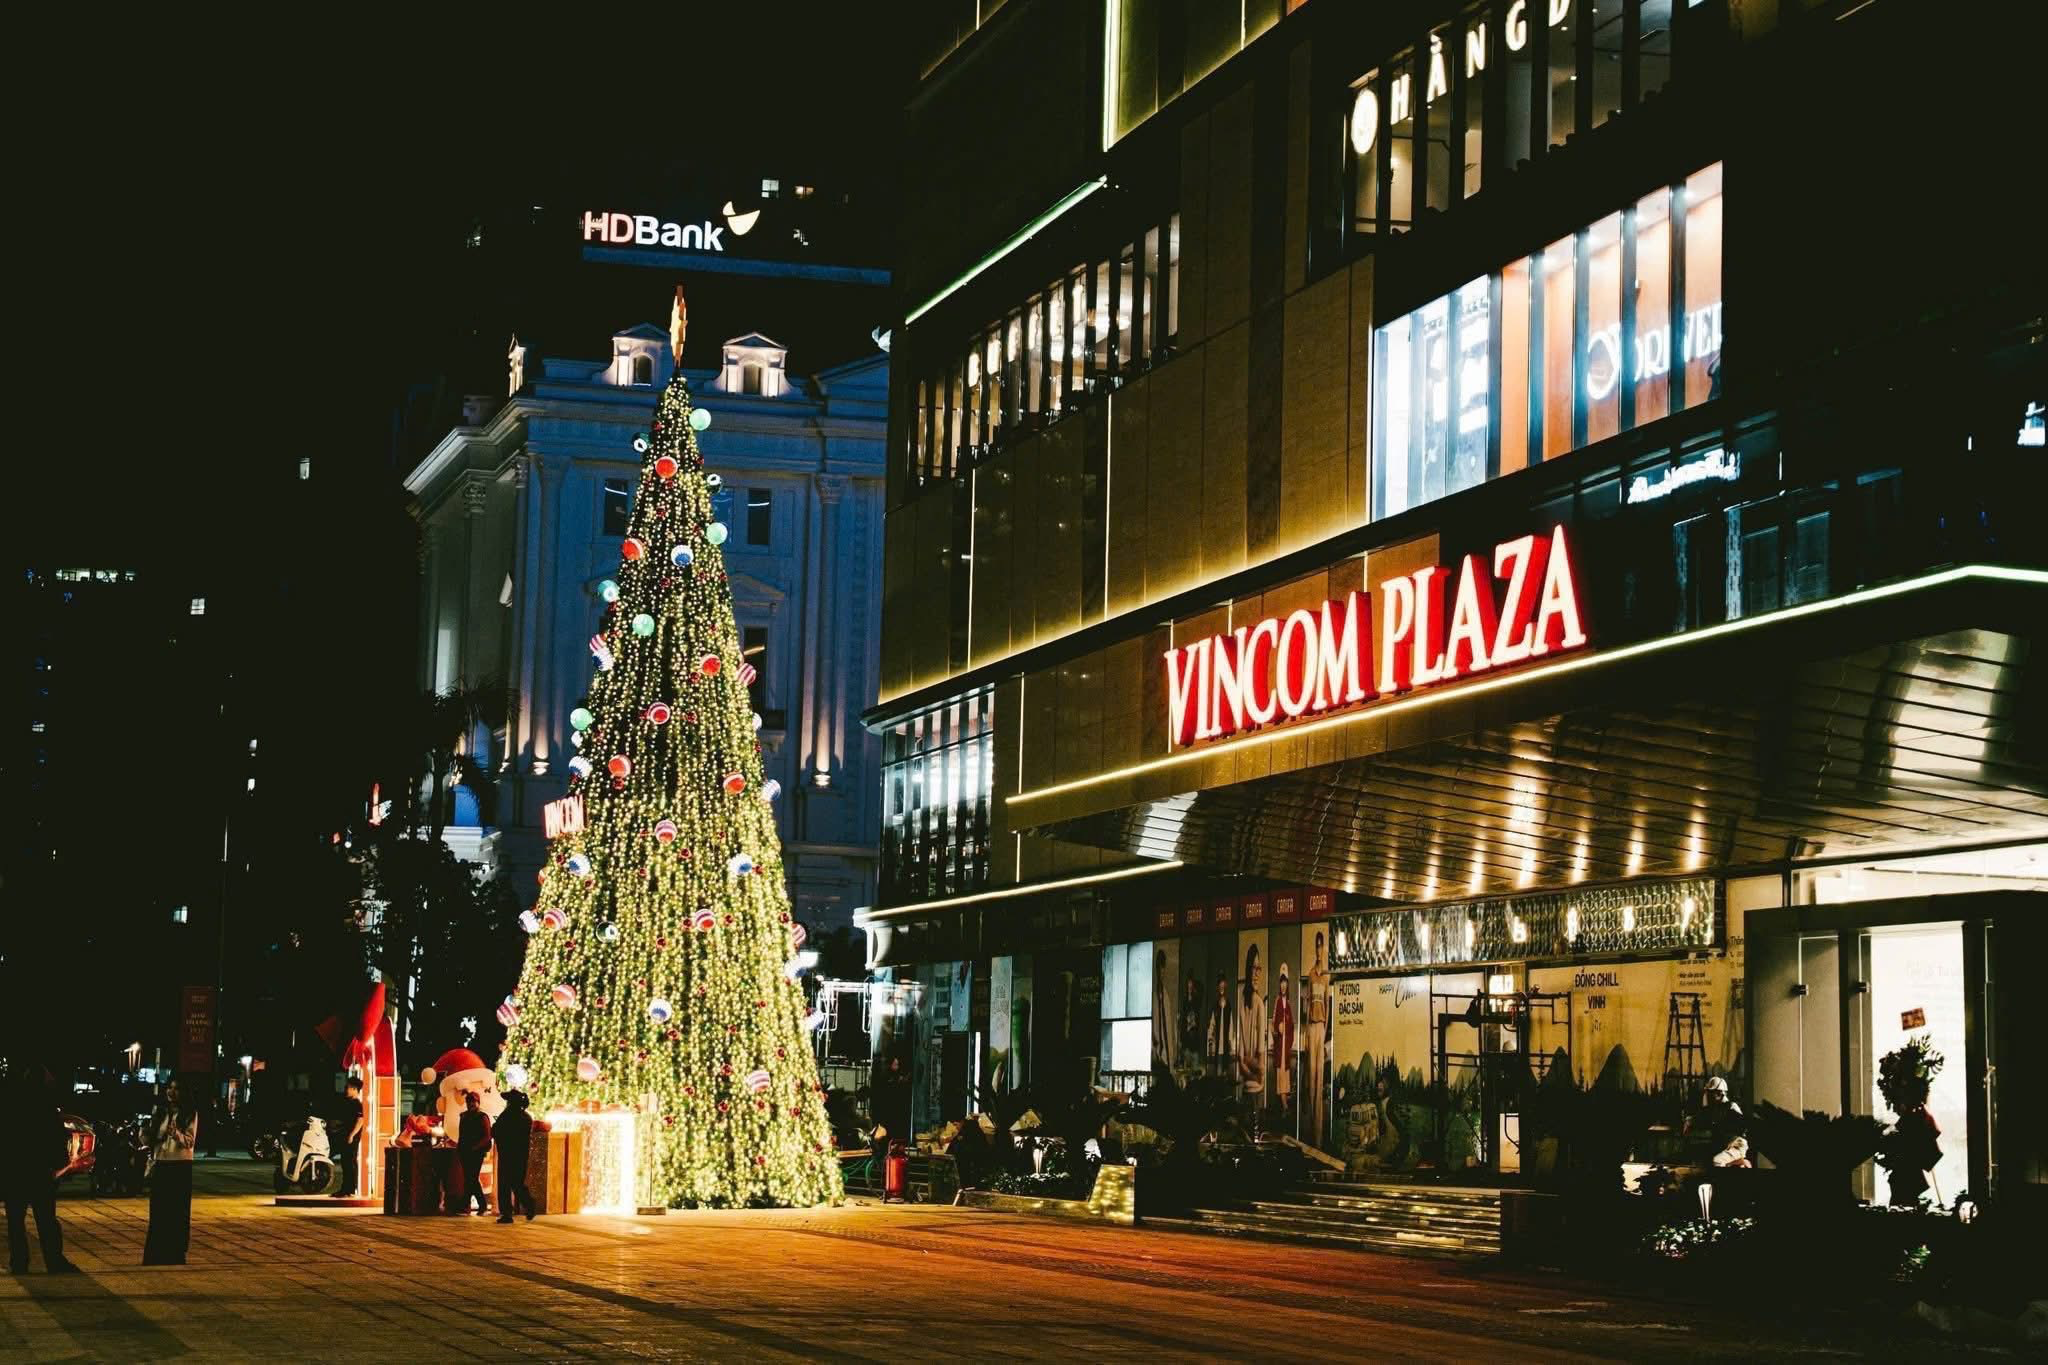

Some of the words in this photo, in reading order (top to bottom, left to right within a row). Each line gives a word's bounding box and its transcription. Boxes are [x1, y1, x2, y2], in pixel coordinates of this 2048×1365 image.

[583, 210, 725, 252] HDBank
[1164, 590, 1374, 746] VINCOM
[1379, 524, 1587, 694] PLAZA
[1597, 972, 1619, 986] CHILL
